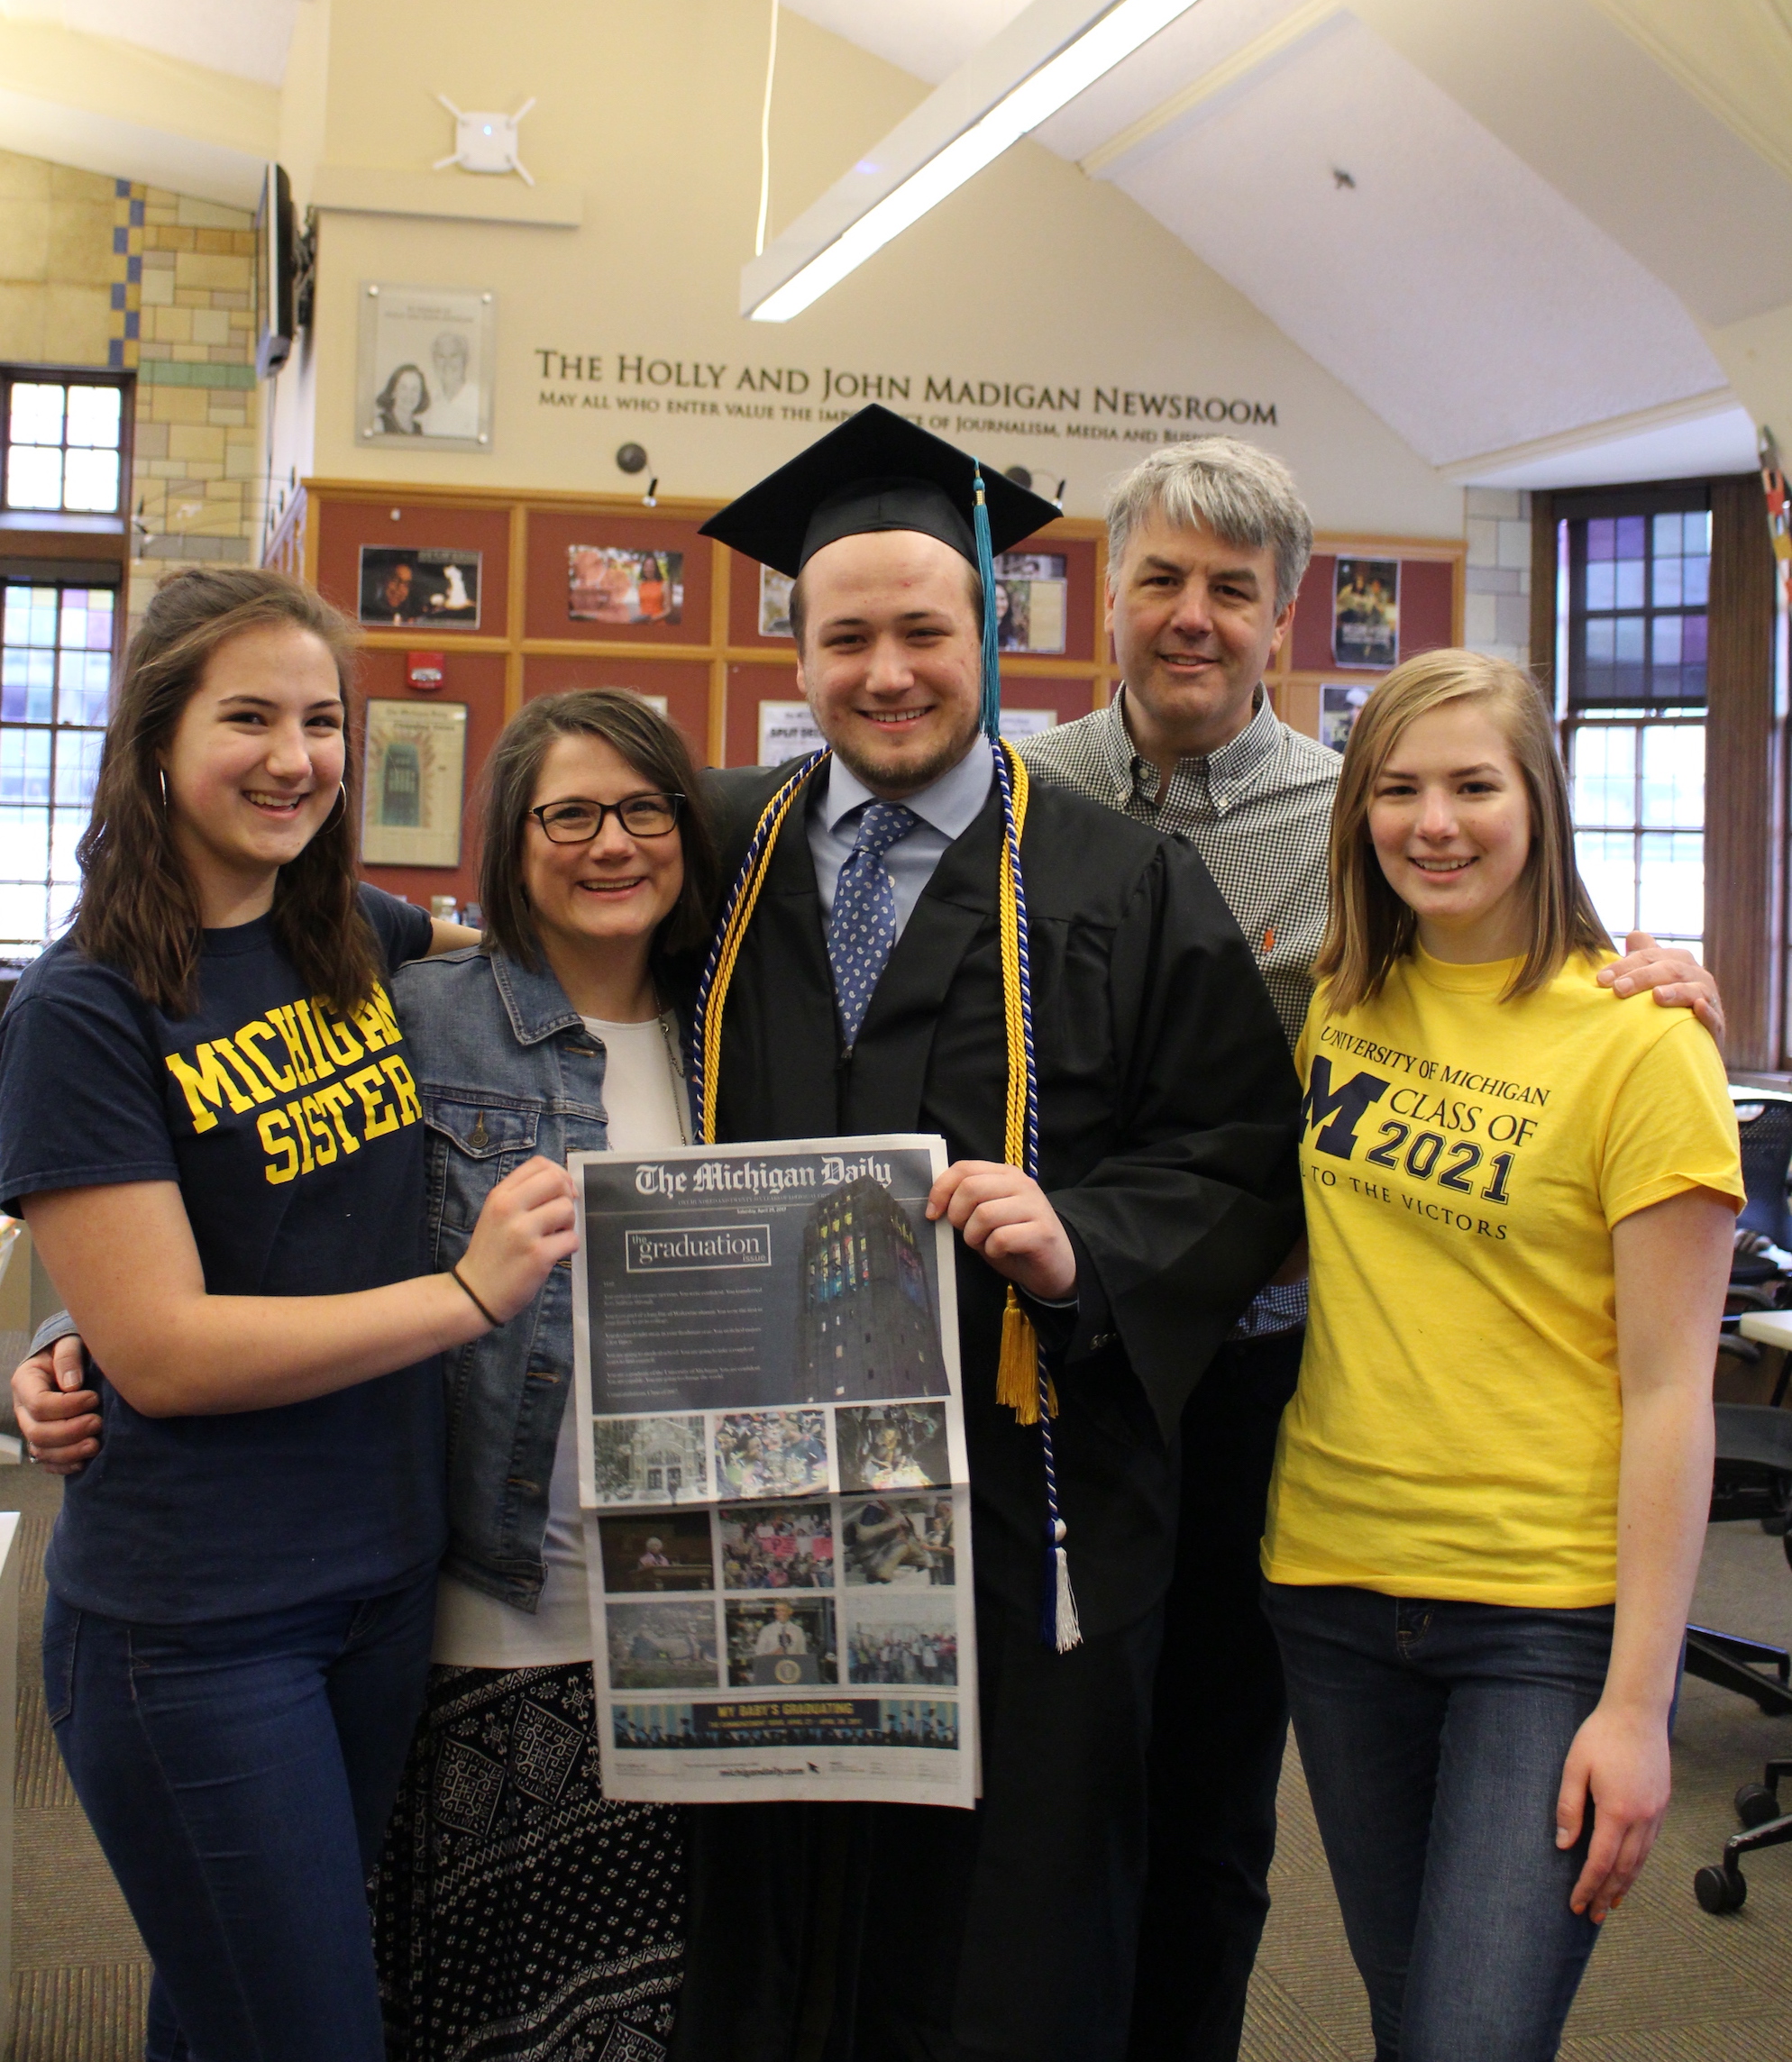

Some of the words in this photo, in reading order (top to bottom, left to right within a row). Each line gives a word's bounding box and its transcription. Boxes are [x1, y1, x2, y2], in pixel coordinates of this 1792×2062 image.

[535, 349, 603, 382] THE
[618, 354, 727, 389] HOLLY
[737, 367, 809, 395] AND
[824, 368, 910, 403] JOHN
[925, 374, 1081, 412] MADIGAN
[1094, 387, 1279, 427] NEWSROOM
[539, 391, 577, 406] MAY
[583, 395, 609, 409] ALL
[617, 397, 660, 413] WHO
[667, 398, 720, 415] ENTER
[727, 404, 773, 420] VALUE
[782, 406, 811, 422] THE
[929, 415, 949, 430] OF
[1066, 424, 1119, 440] MEDIA
[1123, 427, 1157, 443] AND
[165, 976, 403, 1134] MICHIGAN
[1321, 1026, 1417, 1074] UNIVERSITY
[1419, 1060, 1439, 1080] OF
[1441, 1066, 1550, 1107] MICHIGAN
[257, 1054, 423, 1185] SISTER
[1390, 1089, 1483, 1133] CLASS
[1487, 1115, 1538, 1147] OF
[635, 1163, 688, 1200] The
[693, 1161, 817, 1195] Michigan
[821, 1155, 892, 1189] Daily
[1366, 1118, 1515, 1205] 2021
[1312, 1165, 1336, 1186] TO
[1349, 1177, 1391, 1202] THE
[1402, 1194, 1507, 1240] VICTORS
[632, 1235, 646, 1245] the
[639, 1233, 760, 1265] graduation
[743, 1254, 766, 1263] issue
